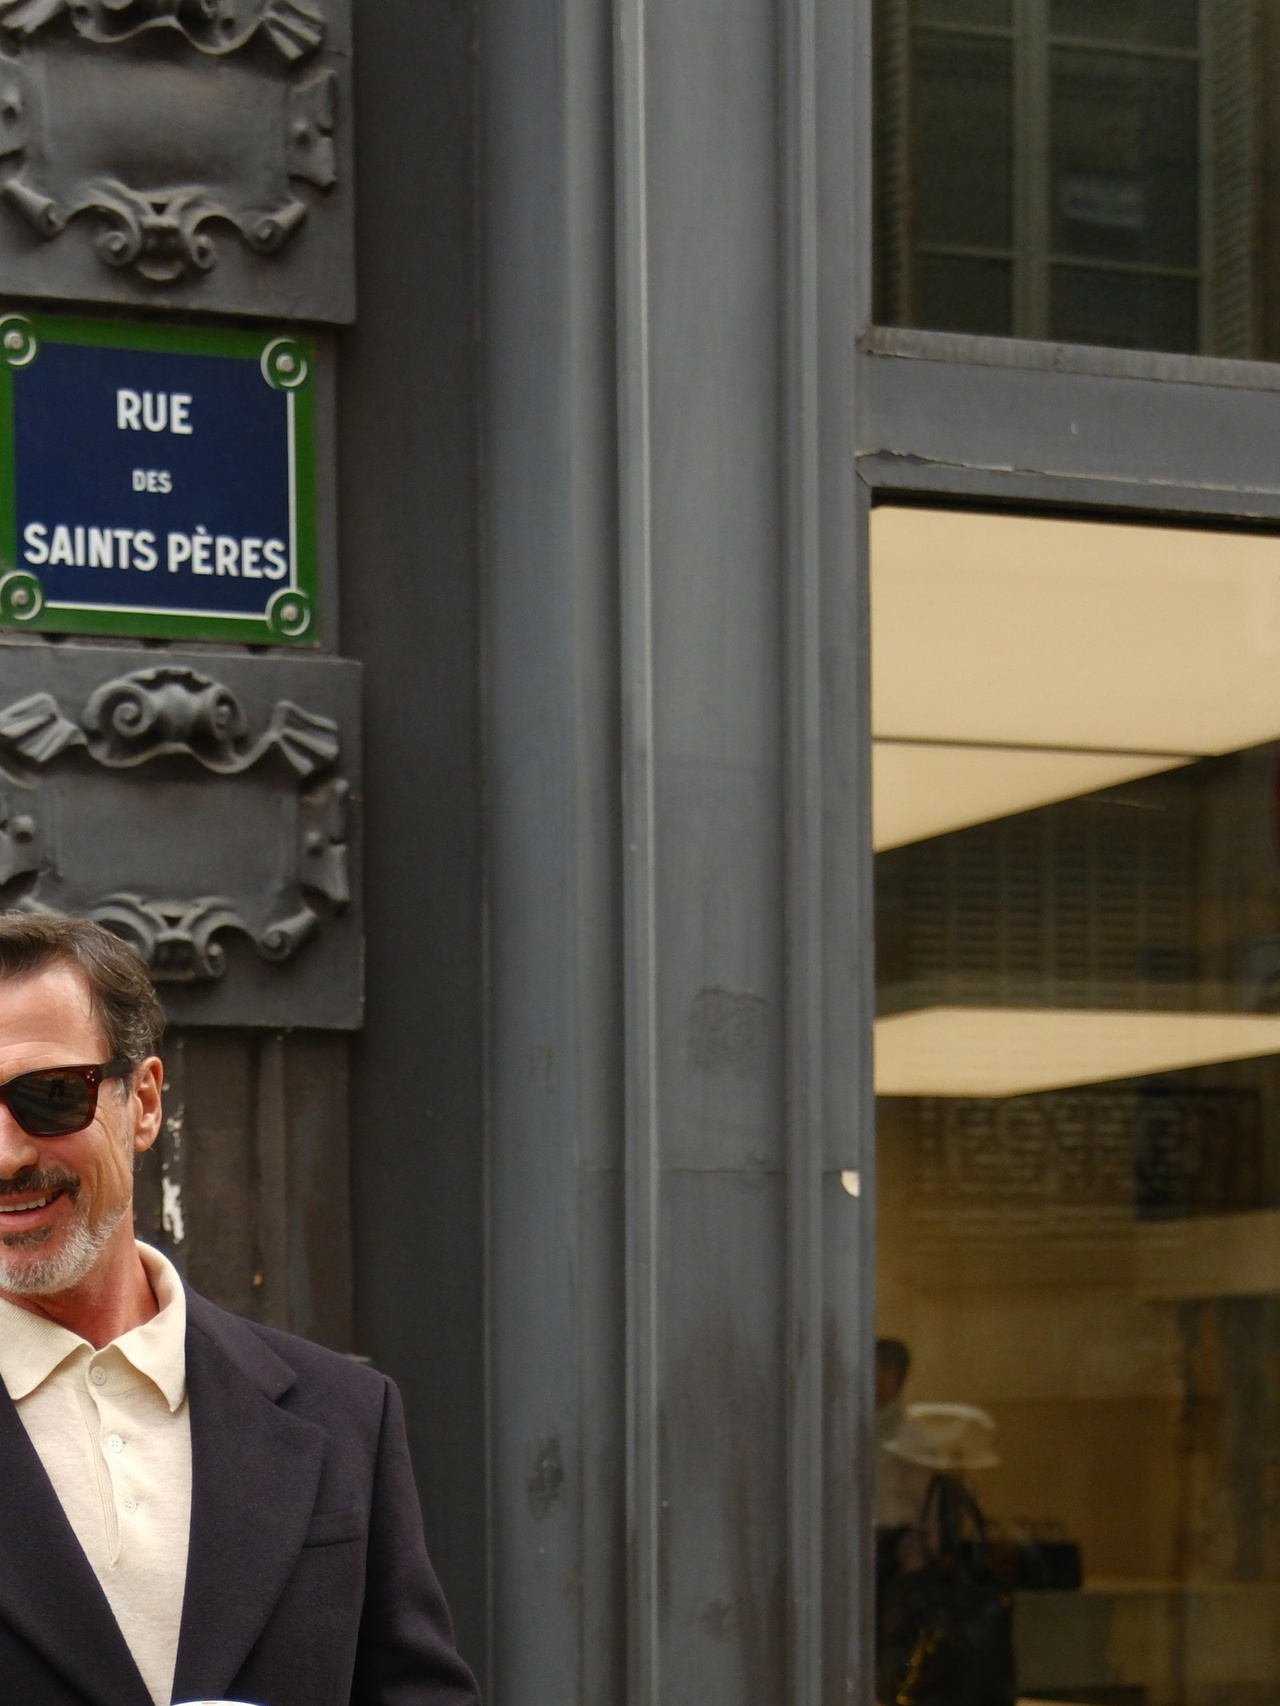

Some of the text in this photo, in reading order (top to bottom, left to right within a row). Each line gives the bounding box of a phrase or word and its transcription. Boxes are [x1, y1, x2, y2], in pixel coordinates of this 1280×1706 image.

[117, 389, 193, 435] RUE
[132, 468, 173, 494] DES
[23, 522, 287, 580] SAINTS PÈRES
